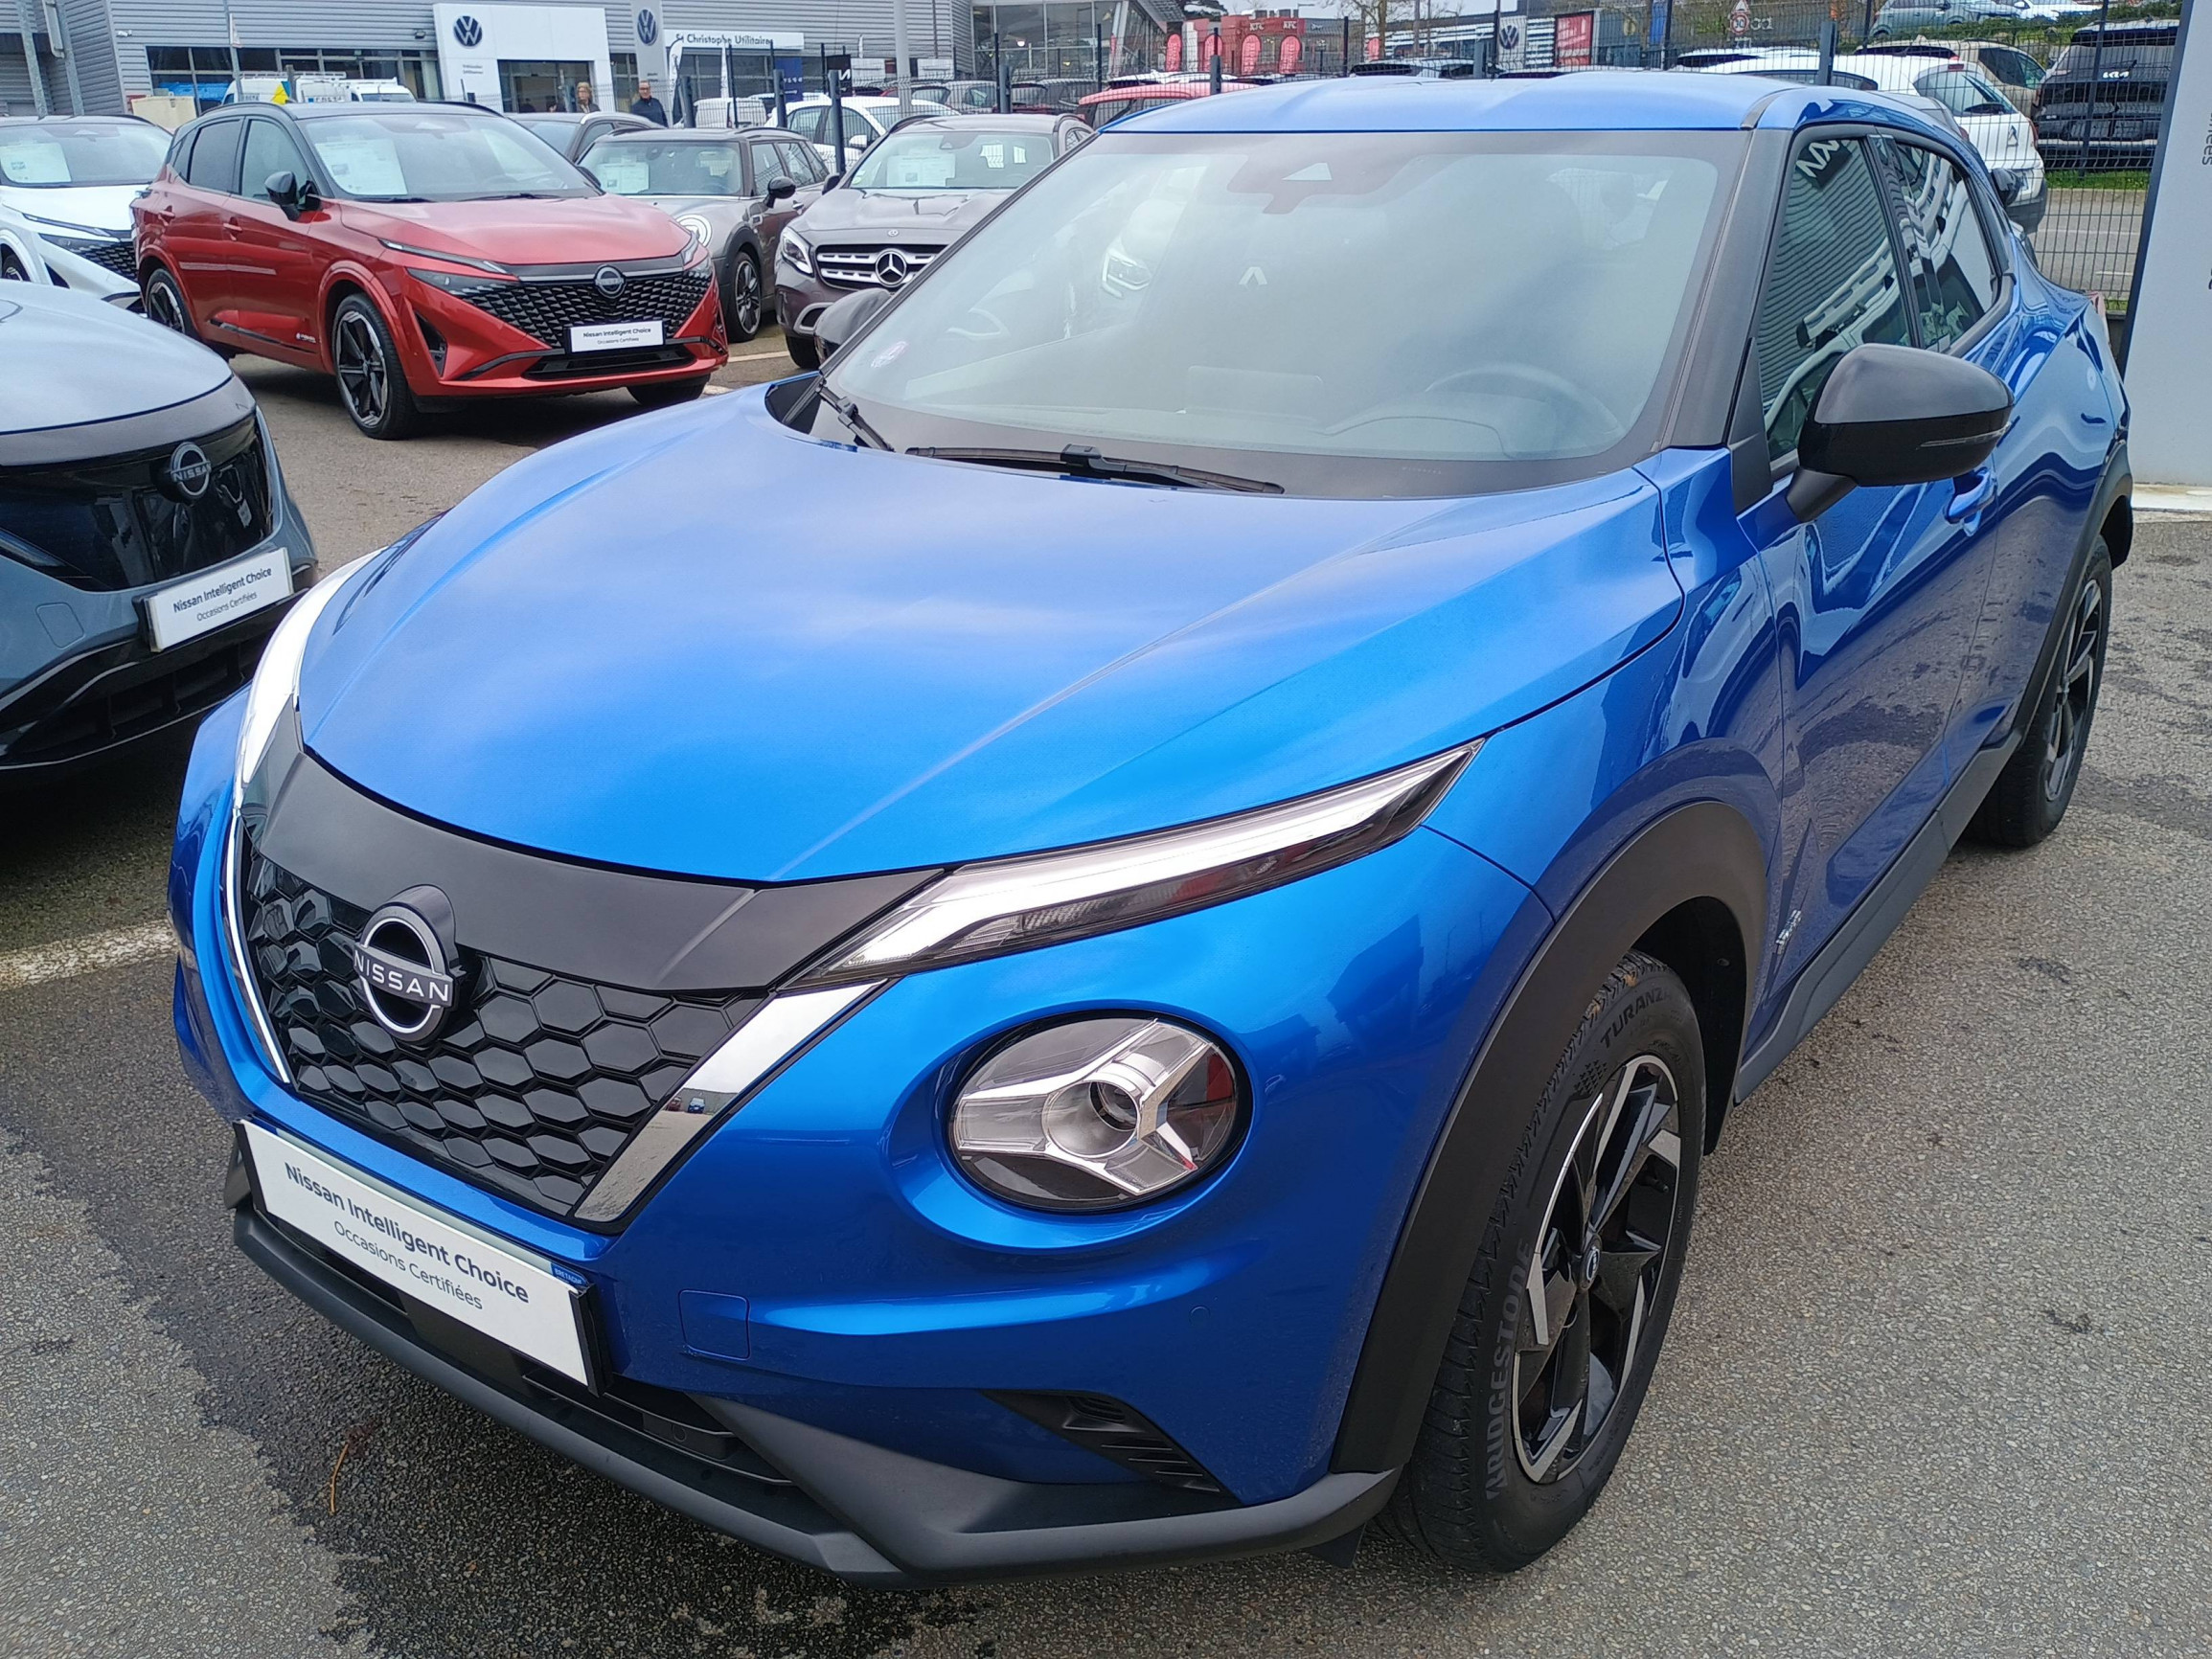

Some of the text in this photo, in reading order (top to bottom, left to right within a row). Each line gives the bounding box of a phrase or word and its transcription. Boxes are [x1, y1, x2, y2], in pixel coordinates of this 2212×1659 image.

[687, 34, 732, 46] Christophe
[604, 329, 632, 337] Intelligent
[173, 463, 212, 482] NISSAN
[172, 567, 272, 613] Nissan Intelligent Choice
[196, 591, 258, 622] Occasions Certifiées
[353, 949, 448, 1002] NISSAN
[285, 1162, 530, 1304] Nissan Intelligent Choice
[333, 1220, 483, 1310] Occasions Certifiées
[1486, 1237, 1533, 1501] BRIDGESTONE
